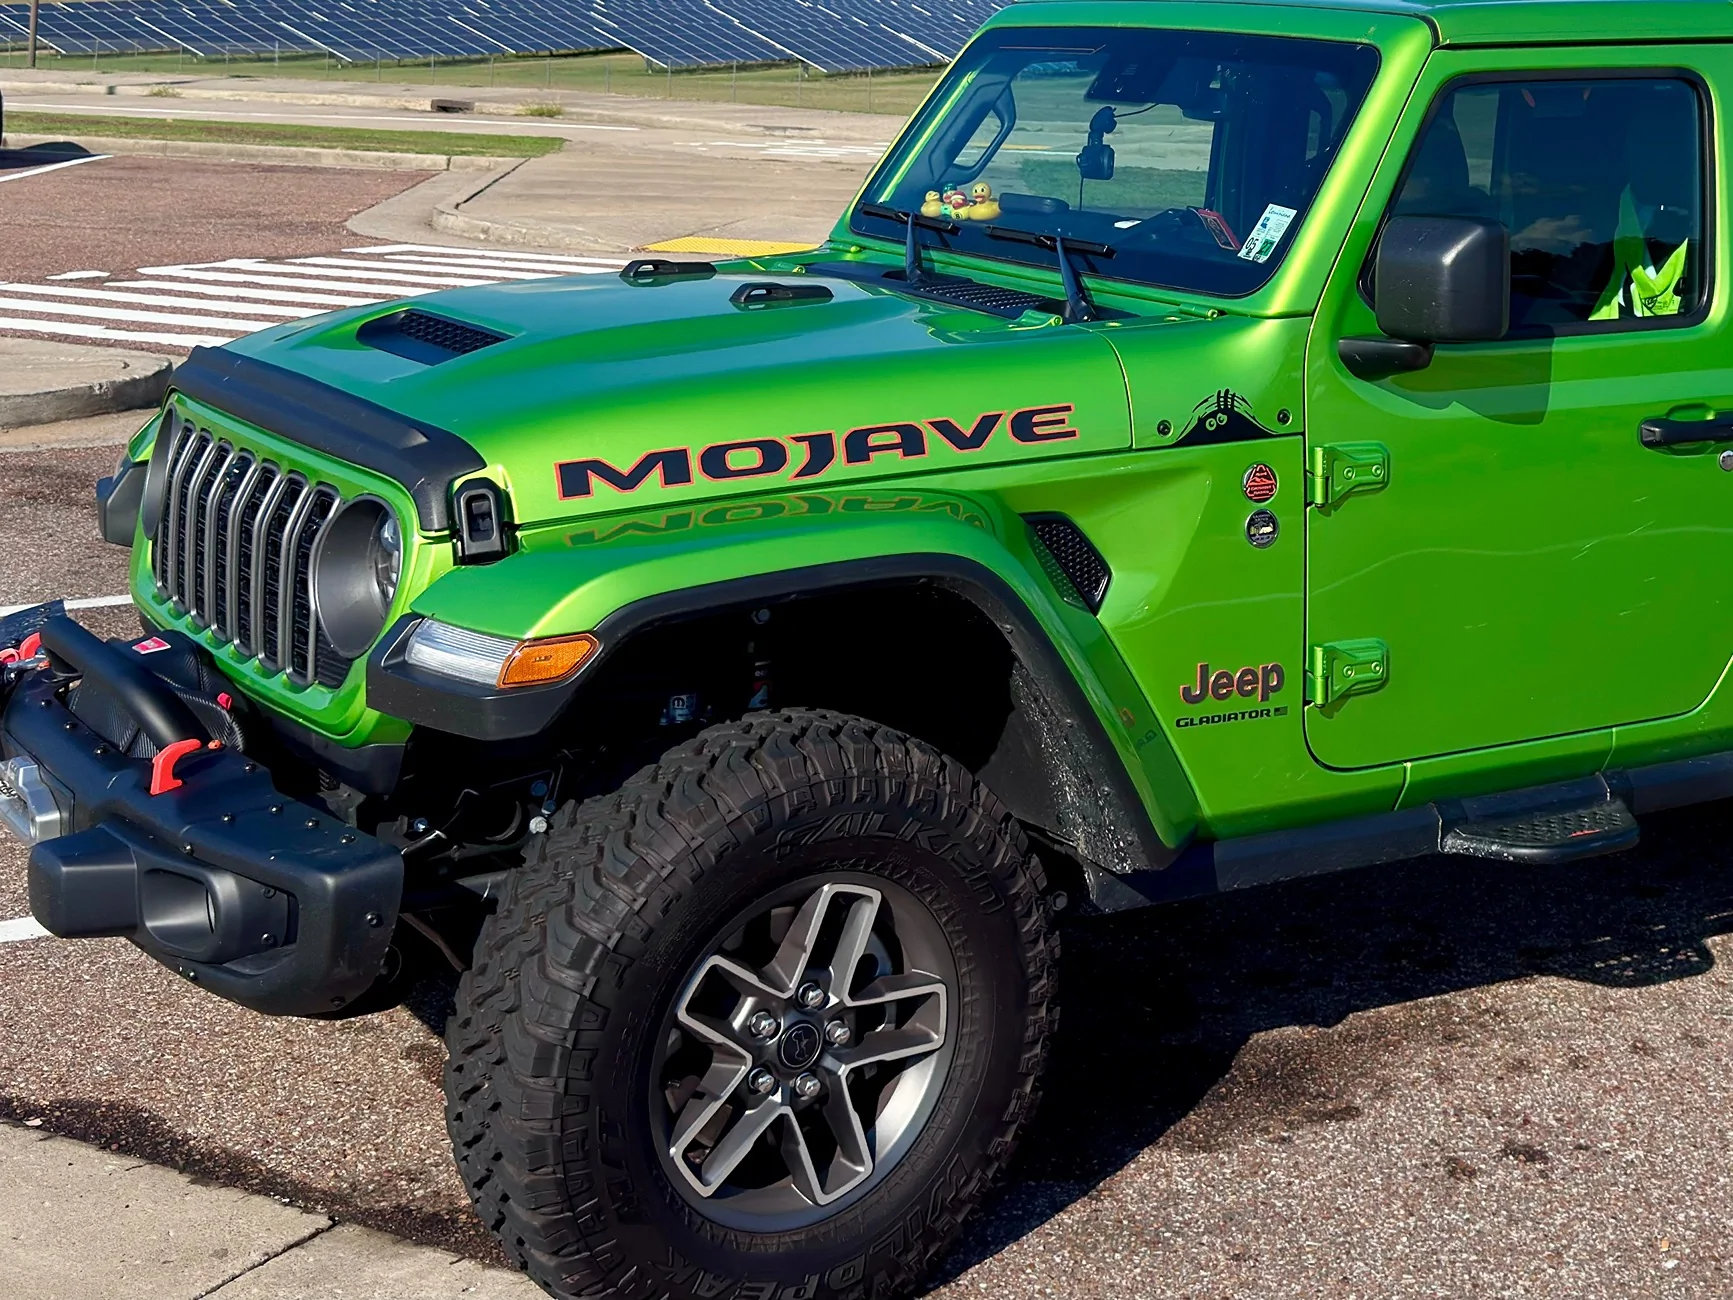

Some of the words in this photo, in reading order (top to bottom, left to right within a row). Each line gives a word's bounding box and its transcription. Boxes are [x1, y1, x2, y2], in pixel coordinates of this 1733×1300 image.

[553, 403, 1080, 500] MOJAVE
[1180, 661, 1285, 705] Jeep
[1175, 708, 1272, 729] GLADIATOR
[762, 808, 1007, 916] FALKEN
